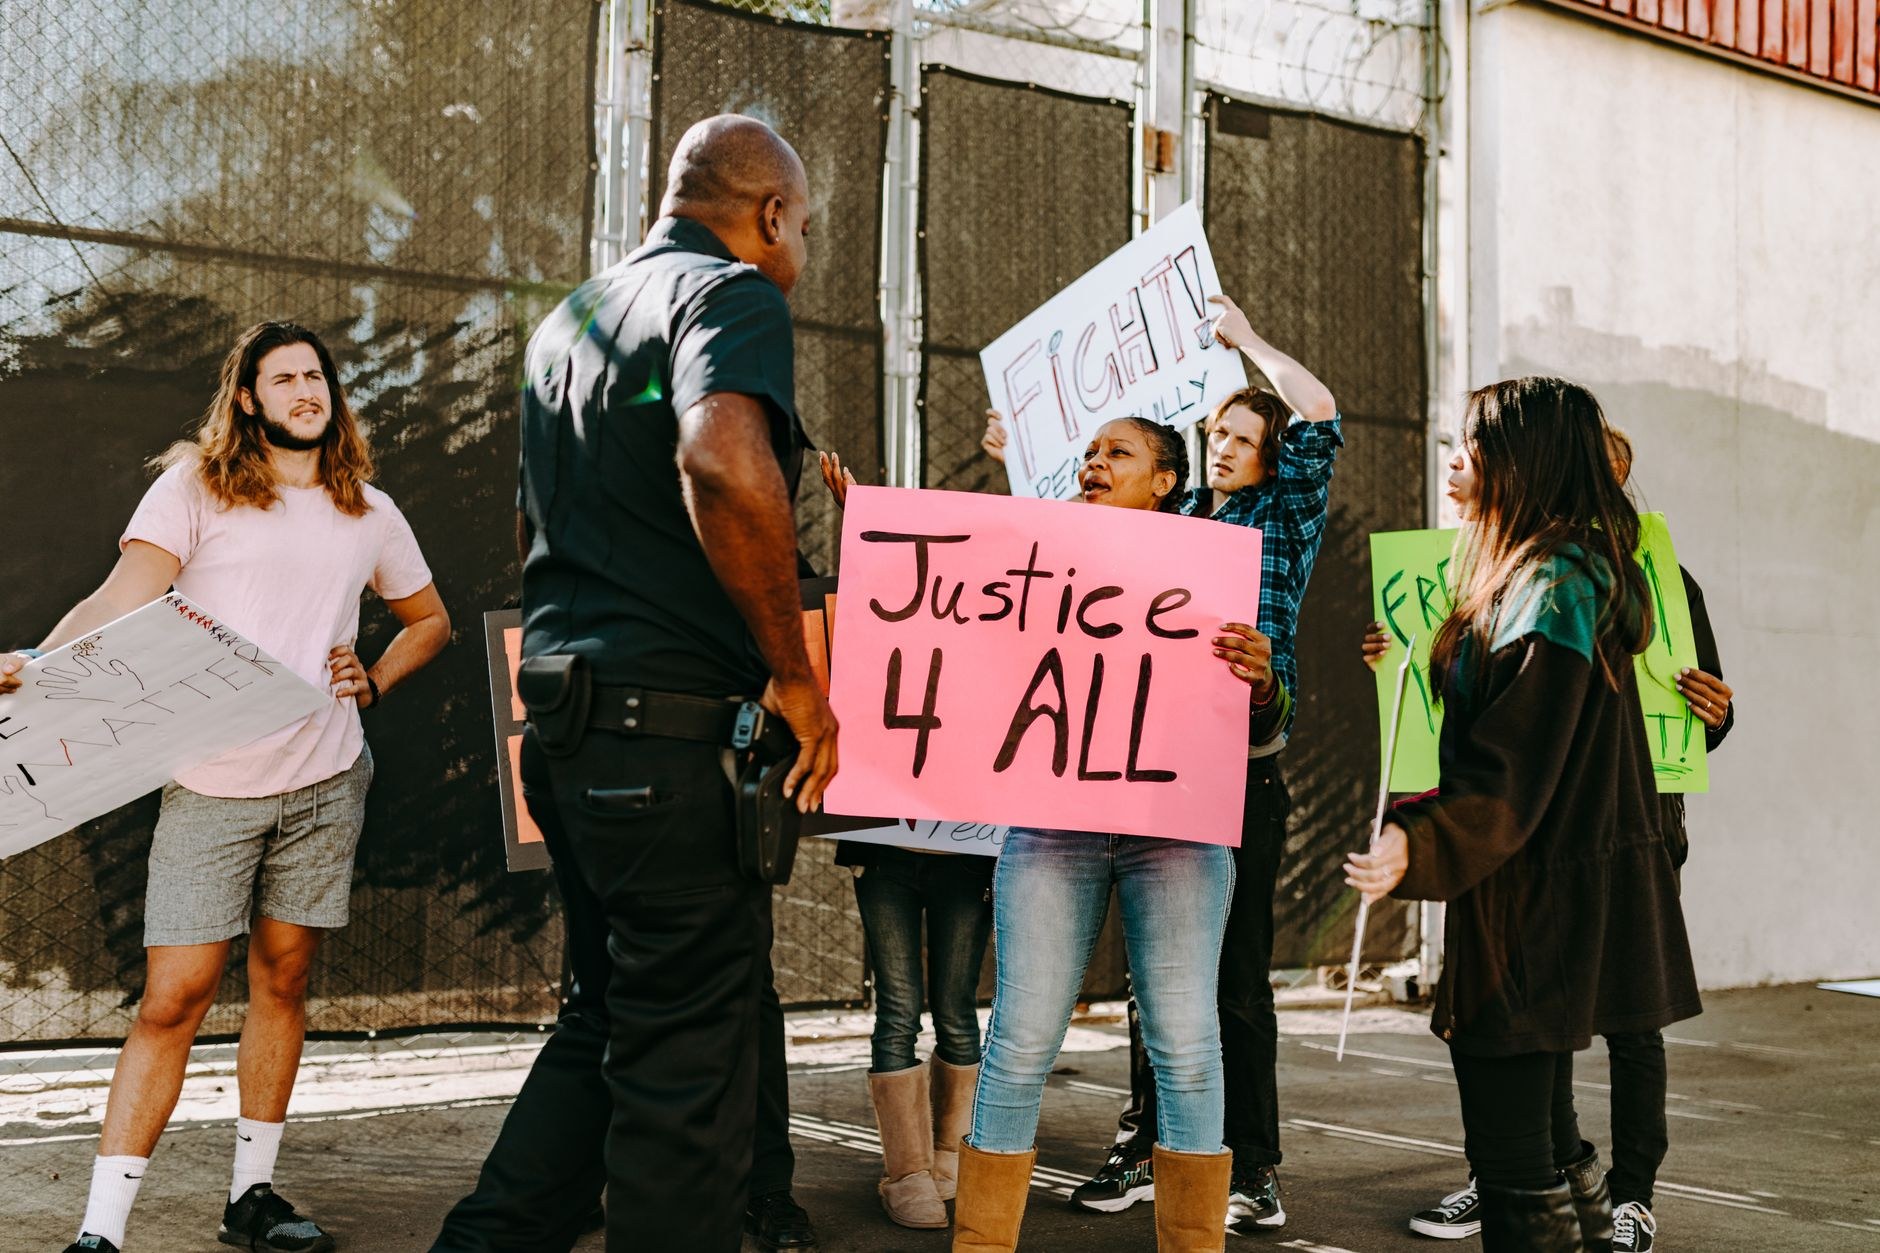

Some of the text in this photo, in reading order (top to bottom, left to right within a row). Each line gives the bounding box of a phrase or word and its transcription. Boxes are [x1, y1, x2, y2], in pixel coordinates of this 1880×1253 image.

[860, 530, 1199, 640] Justice
[16, 642, 282, 787] MATTER
[883, 646, 1178, 783] 4 ALL
